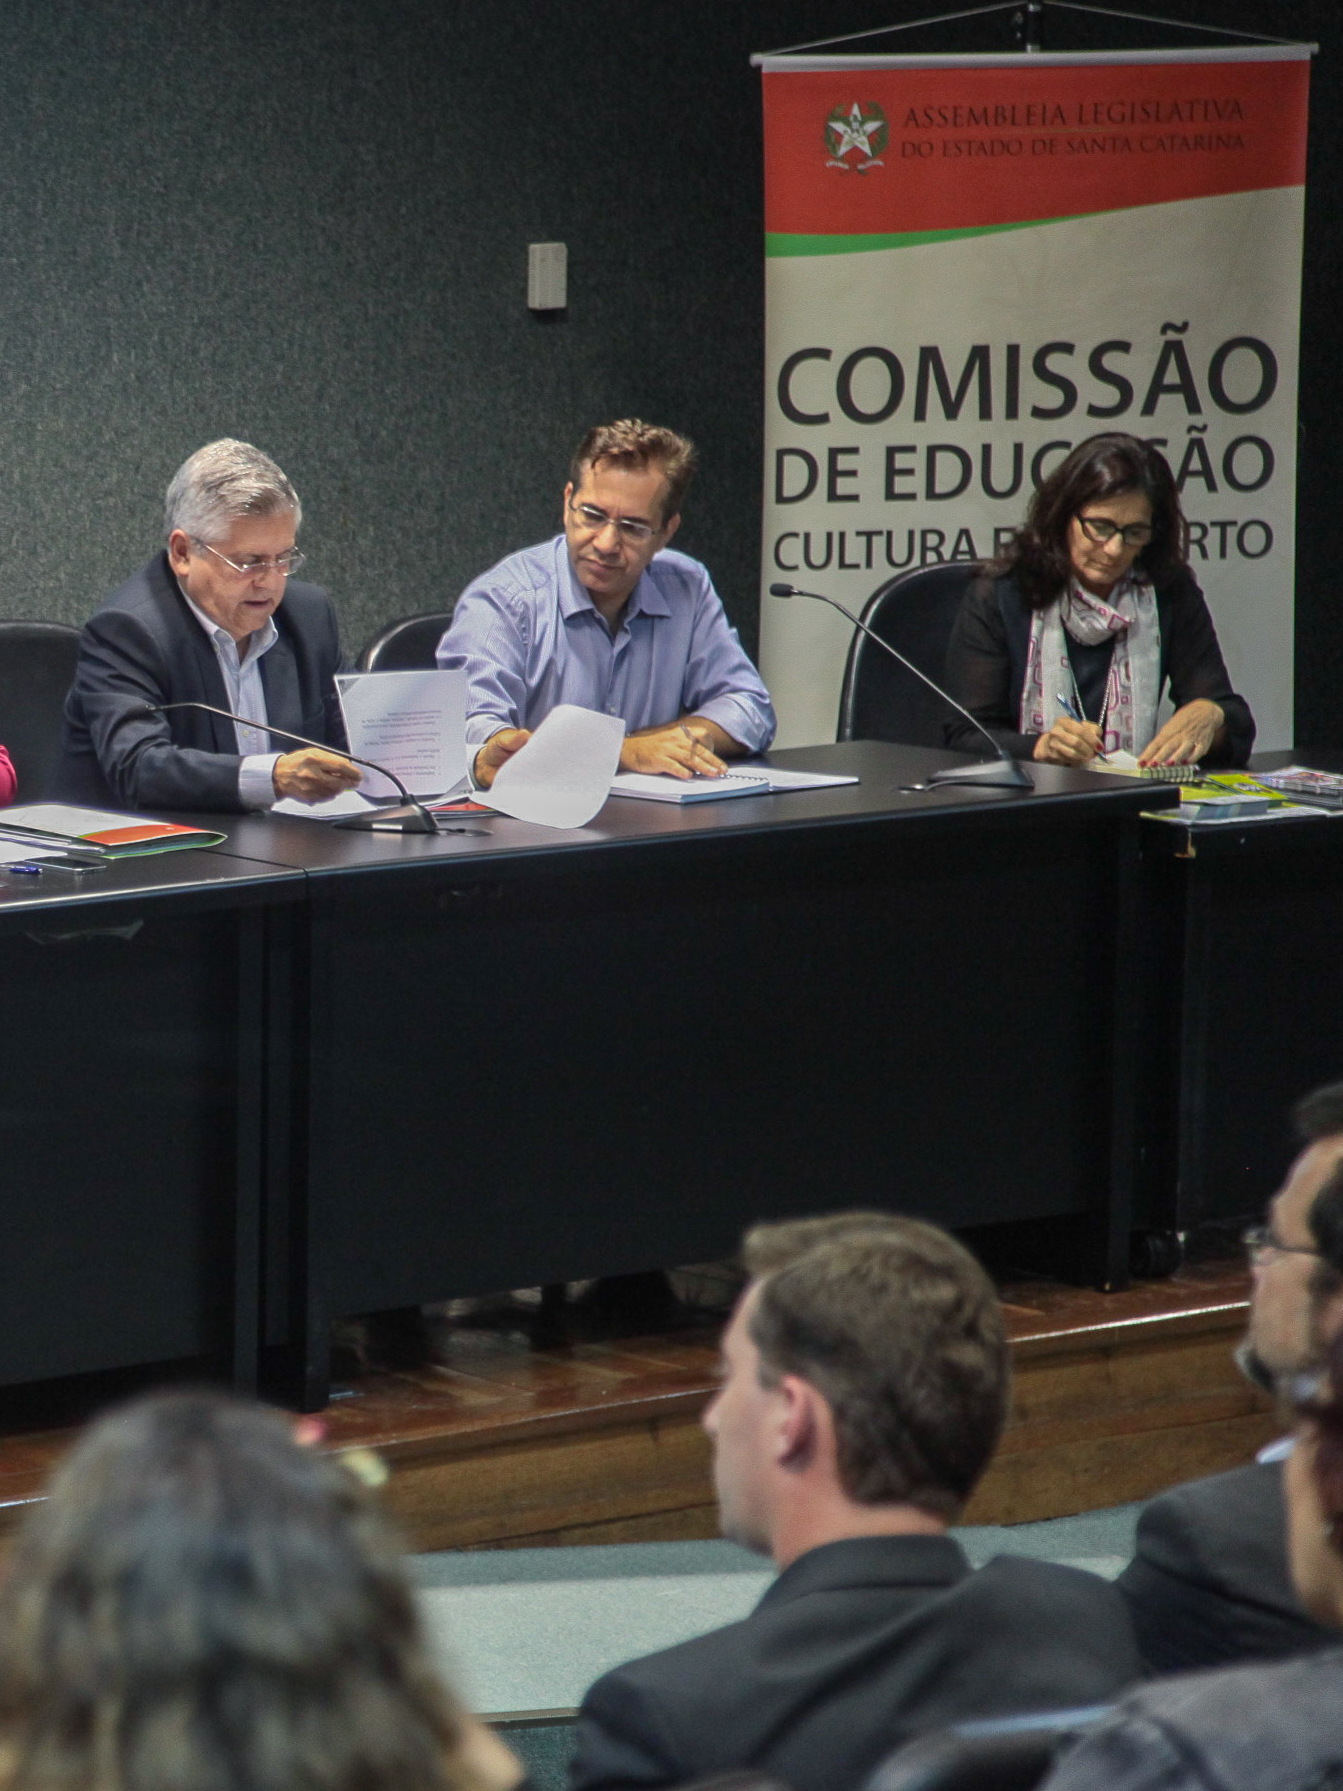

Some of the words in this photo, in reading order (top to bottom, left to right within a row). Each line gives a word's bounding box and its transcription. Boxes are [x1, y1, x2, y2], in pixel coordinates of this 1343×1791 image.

[903, 103, 1067, 129] ASSEMBLEIA
[1077, 99, 1245, 126] LEGISLATIVA
[901, 141, 934, 159] DO
[942, 138, 1023, 158] ESTADO
[1031, 138, 1056, 156] DE
[1066, 136, 1132, 155] SANTA
[1139, 132, 1245, 153] CATARINA
[776, 321, 1279, 426] COMISSÃO
[775, 446, 860, 505] DE
[884, 423, 1276, 503] EDUCÃO
[773, 527, 979, 572] CULTURA
